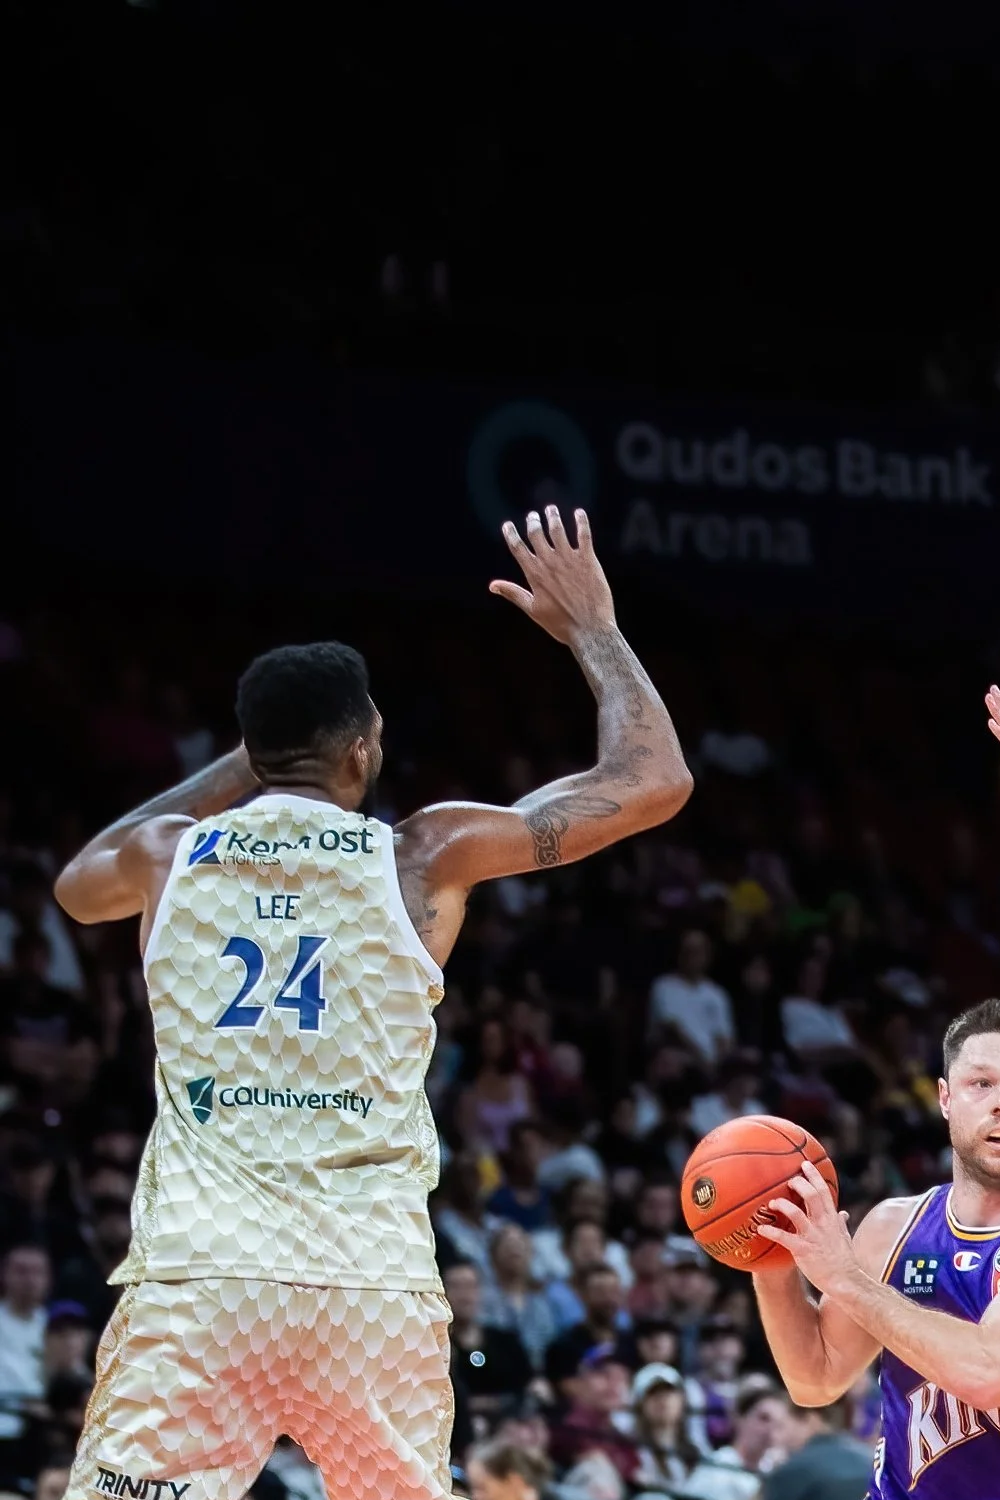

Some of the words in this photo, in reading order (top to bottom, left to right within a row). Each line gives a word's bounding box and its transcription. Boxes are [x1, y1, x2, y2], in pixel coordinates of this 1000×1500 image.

[614, 418, 830, 494] Qudos
[836, 438, 995, 508] Bank
[620, 497, 815, 567] Arena
[255, 894, 300, 922] LEE
[213, 934, 330, 1034] 24
